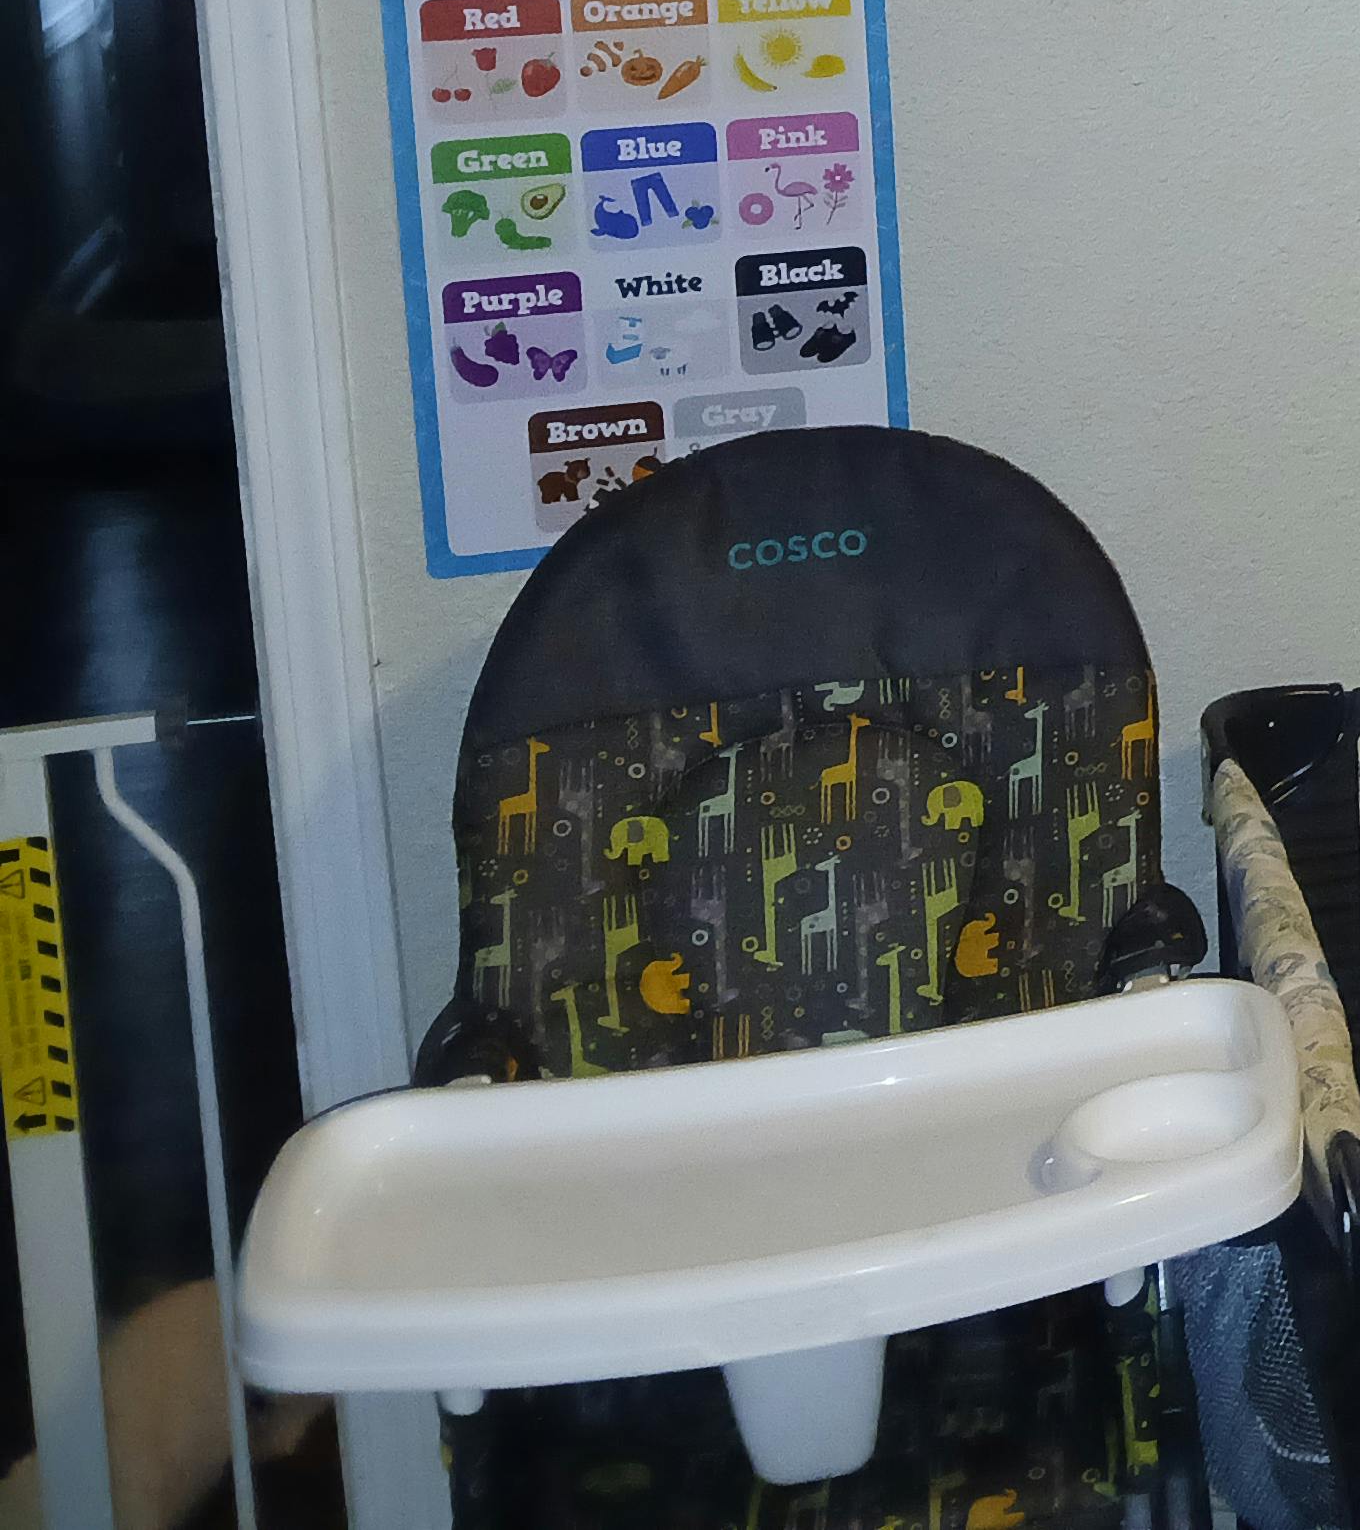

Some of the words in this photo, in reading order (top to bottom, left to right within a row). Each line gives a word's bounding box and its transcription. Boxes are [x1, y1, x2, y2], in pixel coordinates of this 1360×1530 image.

[463, 6, 520, 30] Red
[758, 125, 827, 148] Pink
[457, 150, 548, 172] Green
[616, 138, 681, 160] Blue
[759, 259, 844, 287] Black
[616, 274, 703, 299] White
[461, 285, 564, 316] Purple
[701, 404, 777, 427] Gray
[546, 415, 647, 444] Brown
[728, 529, 867, 570] COSCO
